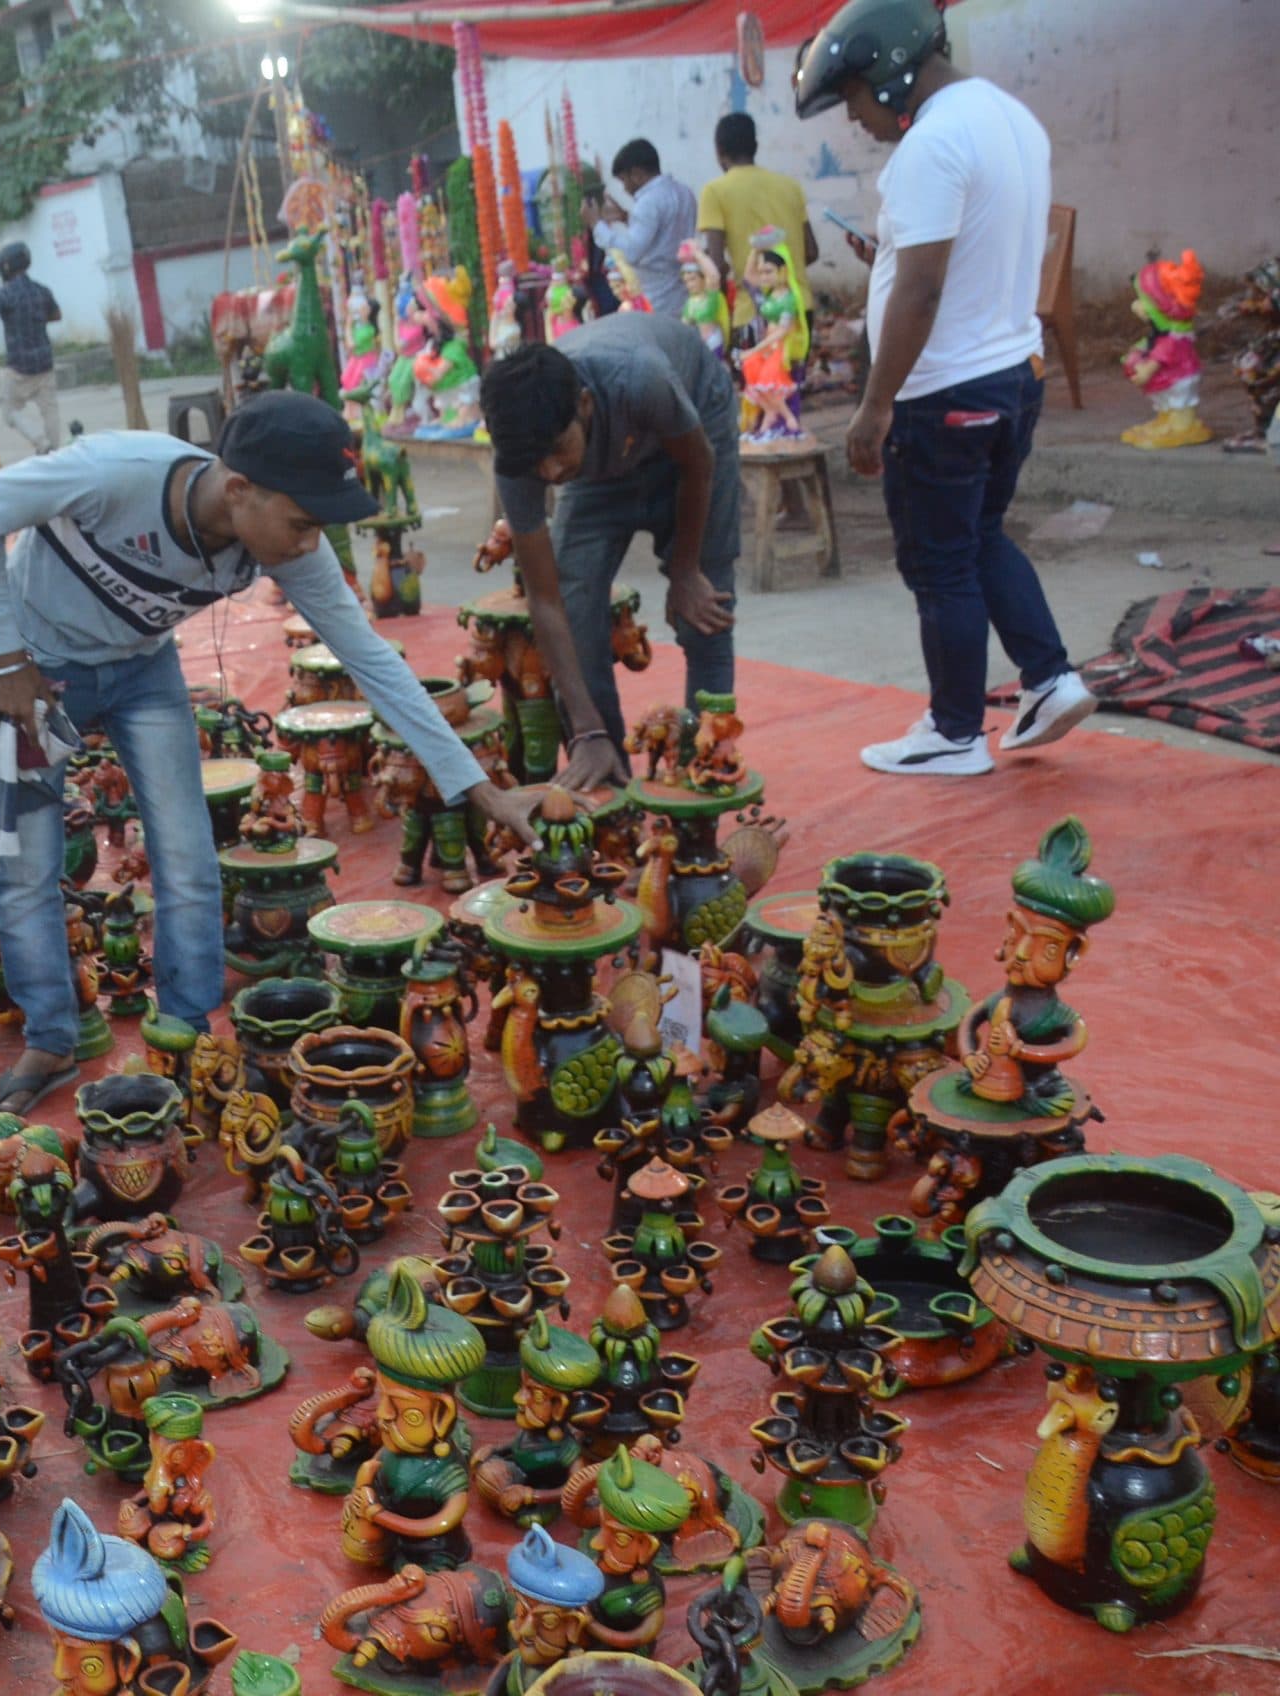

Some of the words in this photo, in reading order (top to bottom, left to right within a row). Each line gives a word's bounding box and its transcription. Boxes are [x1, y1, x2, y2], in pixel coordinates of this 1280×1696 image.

[121, 545, 163, 567] adidas
[82, 562, 147, 606] JUST
[144, 606, 186, 626] DO
